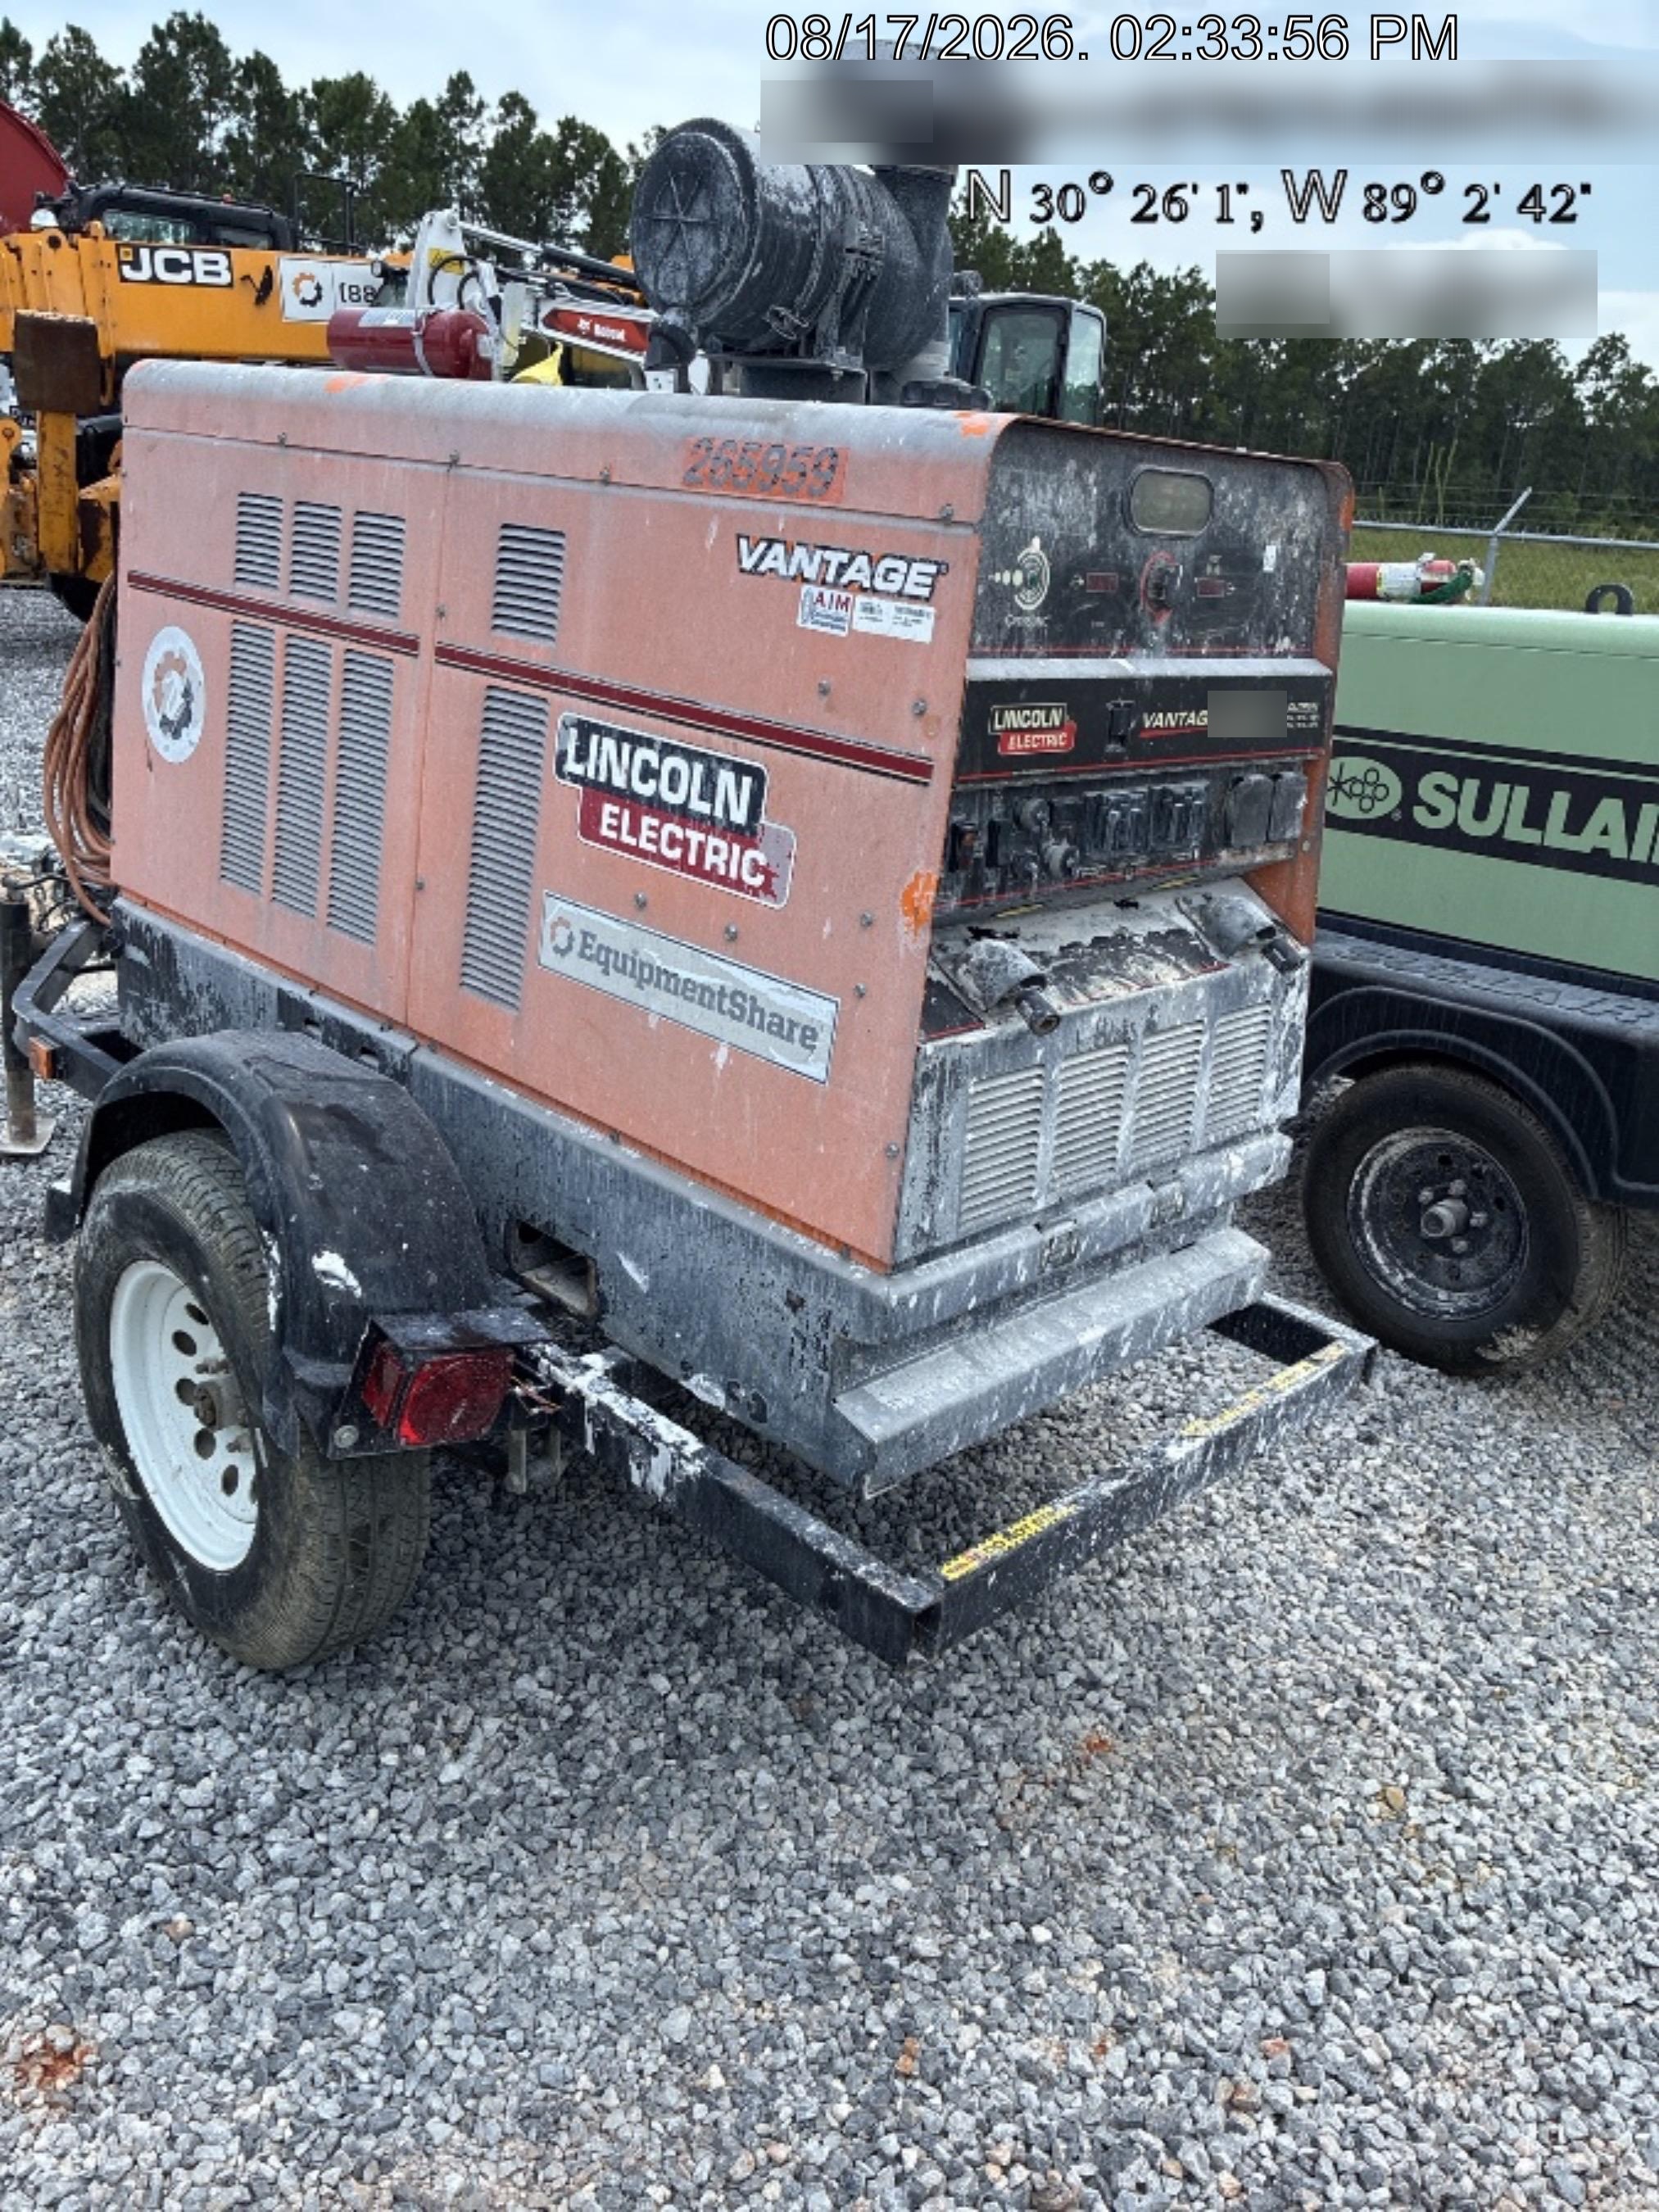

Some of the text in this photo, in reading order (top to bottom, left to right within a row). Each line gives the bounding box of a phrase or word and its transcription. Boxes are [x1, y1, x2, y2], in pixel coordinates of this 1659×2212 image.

[122, 247, 231, 285] JCB
[737, 534, 940, 601] VANTAGE
[994, 706, 1063, 731] LINCOLN
[1007, 732, 1067, 750] ELECTRIC
[1142, 709, 1208, 728] VANTAG
[562, 727, 753, 826] LINCOLN
[600, 803, 768, 886] ELECTRIC
[1412, 771, 1659, 864] SULLAI
[577, 928, 818, 1049] EquipmentShare
